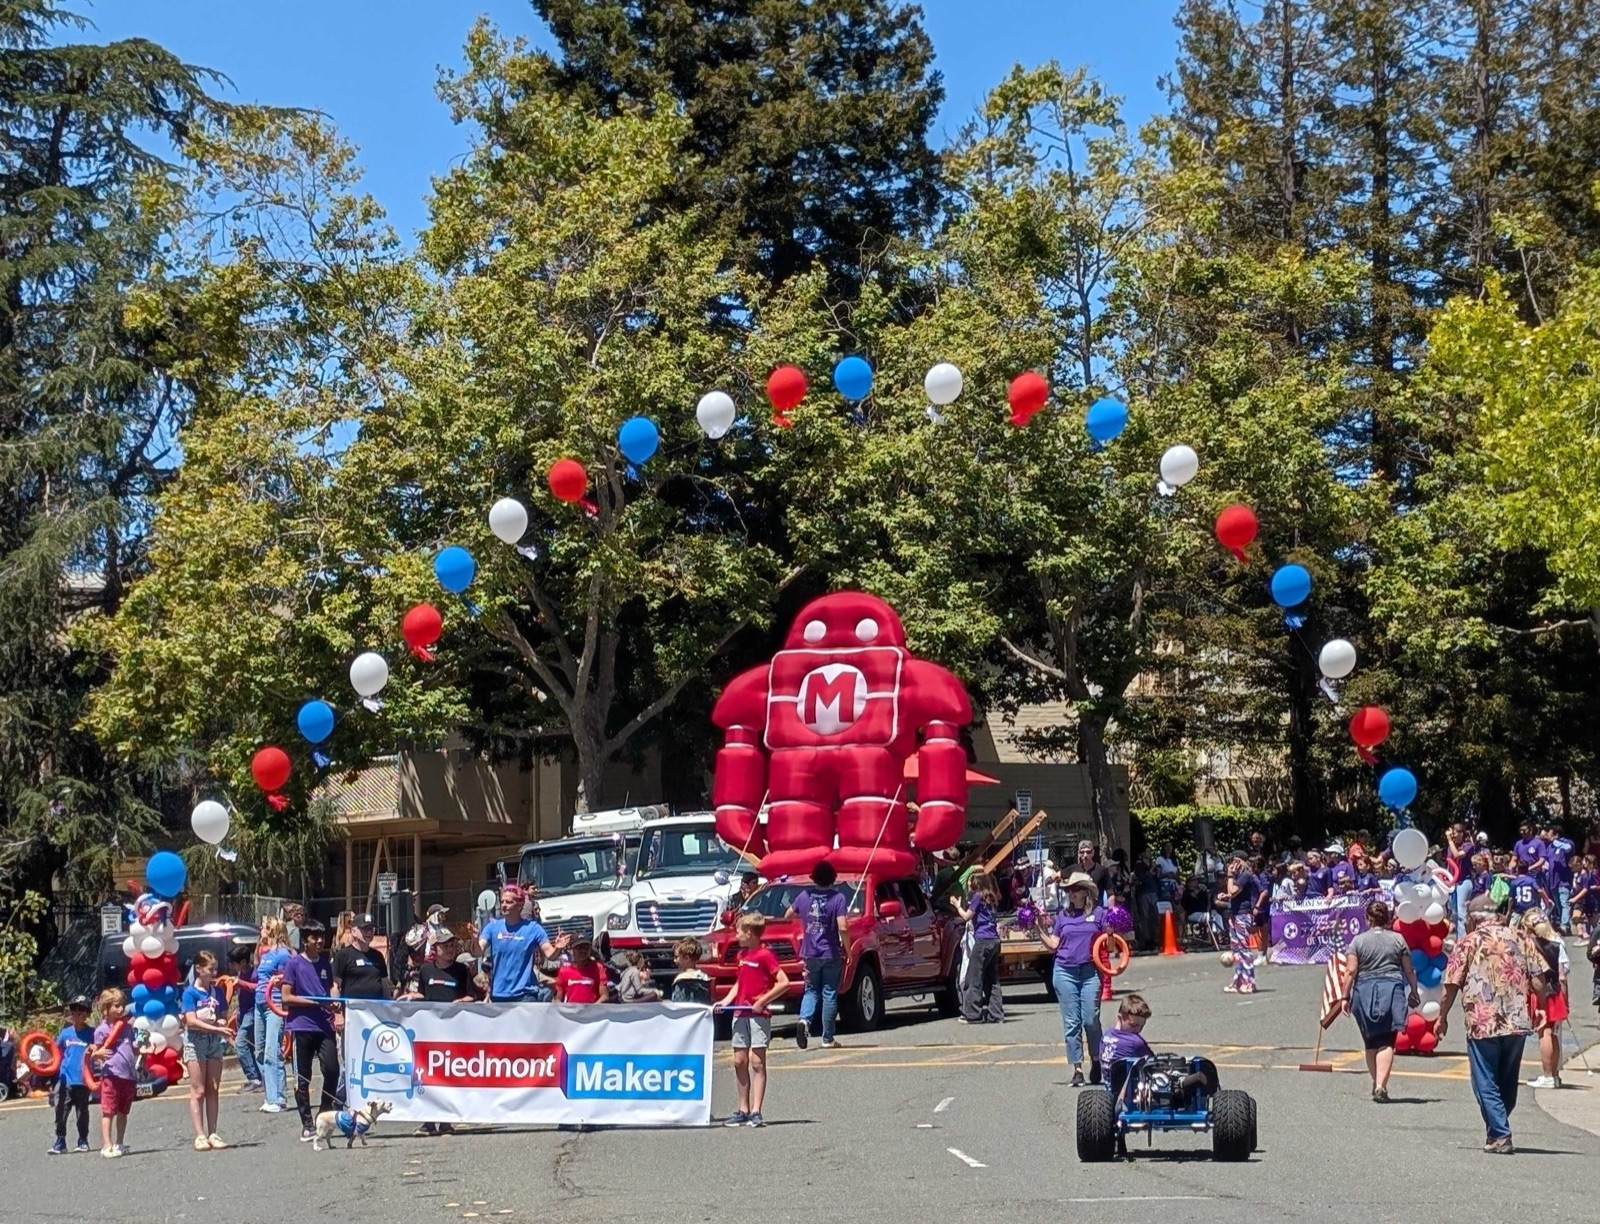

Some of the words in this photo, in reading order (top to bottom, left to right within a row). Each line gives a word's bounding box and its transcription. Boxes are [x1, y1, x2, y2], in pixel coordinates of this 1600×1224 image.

[804, 671, 858, 725] M
[380, 1035, 394, 1048] M
[428, 1050, 556, 1078] Piedmont
[575, 1061, 696, 1092] Makers
